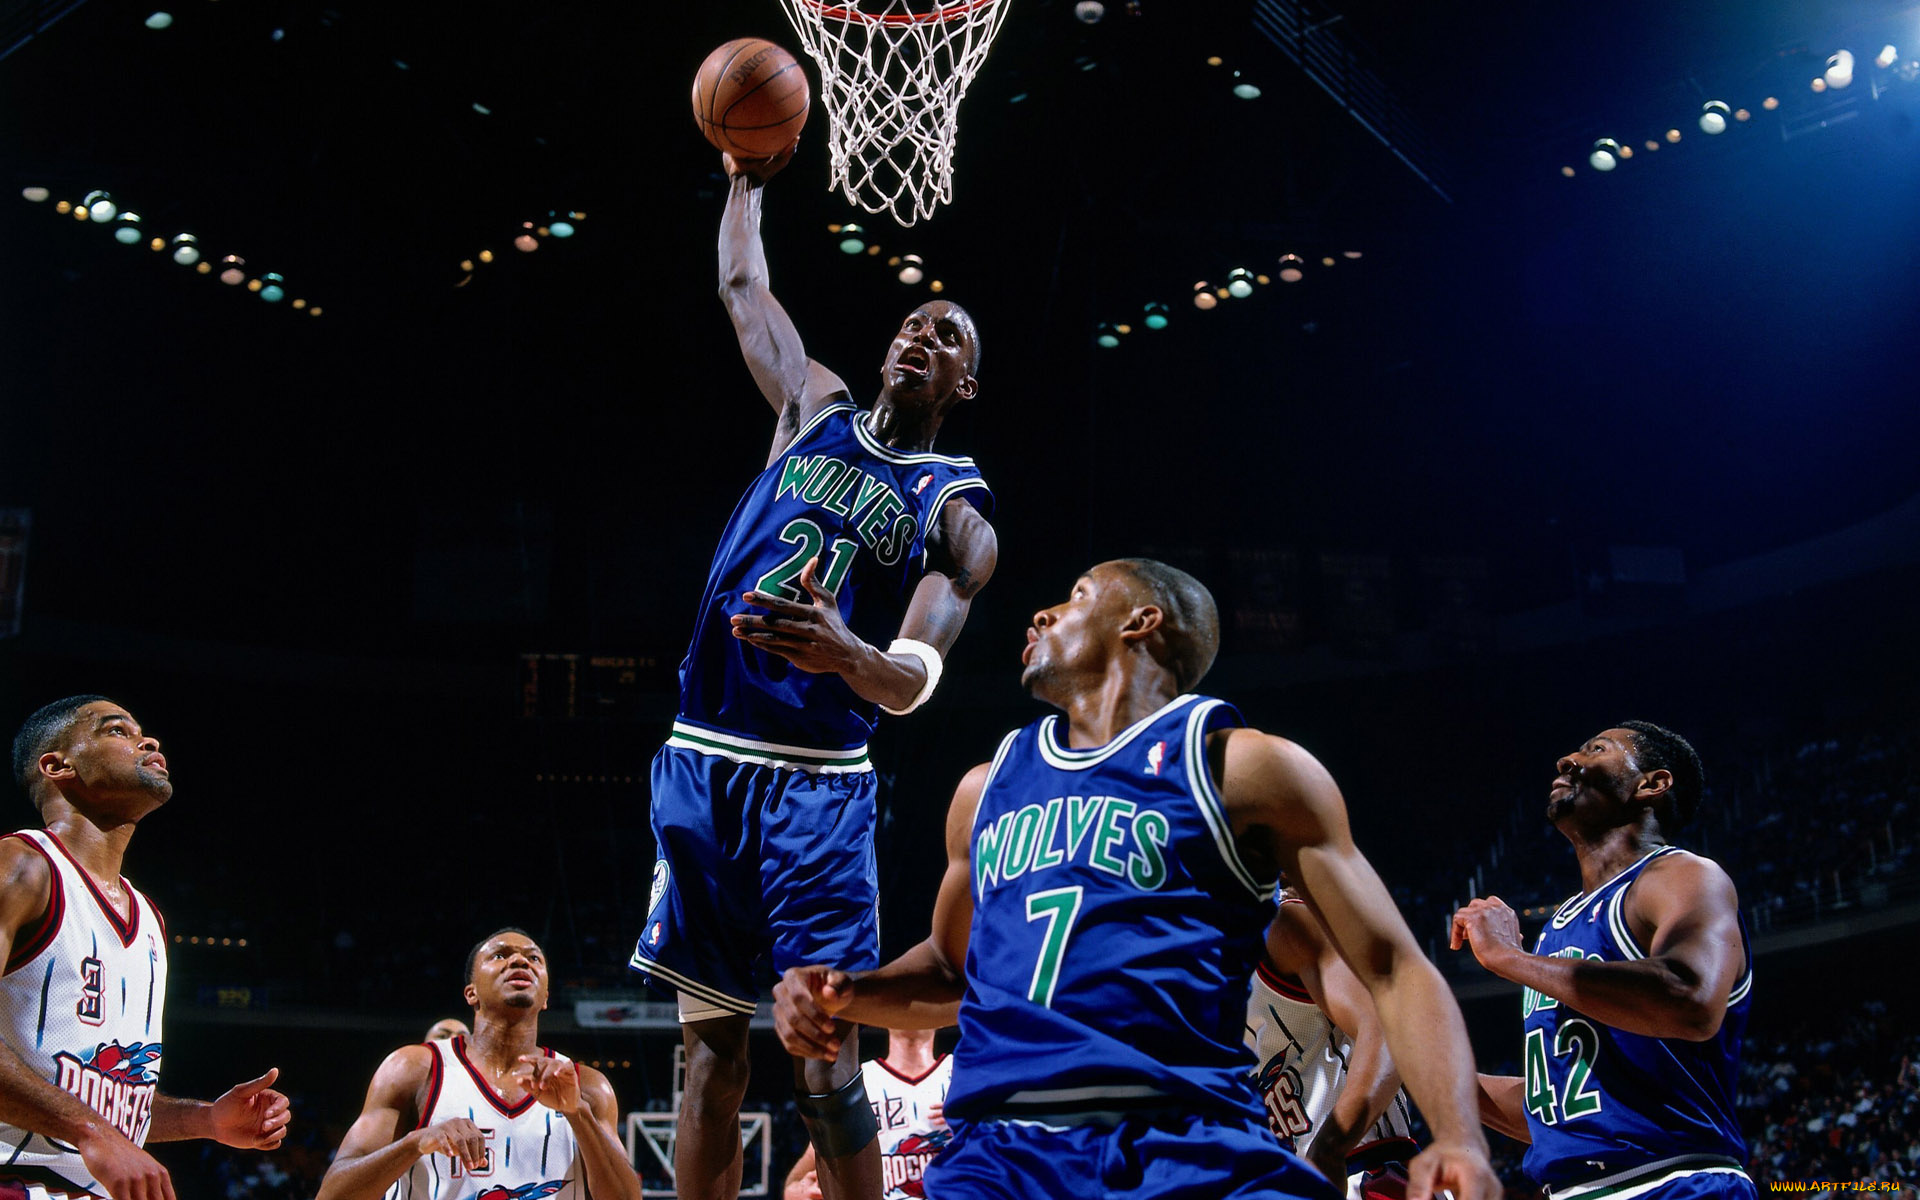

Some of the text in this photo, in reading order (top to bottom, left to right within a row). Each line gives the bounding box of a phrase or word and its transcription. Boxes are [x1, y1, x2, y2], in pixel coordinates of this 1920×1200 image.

[755, 518, 859, 602] 21
[775, 455, 918, 566] WOLVES
[976, 796, 1170, 903] WOLVES
[76, 956, 106, 1028] 3
[1025, 885, 1084, 1010] 7
[1525, 1018, 1602, 1126] 42
